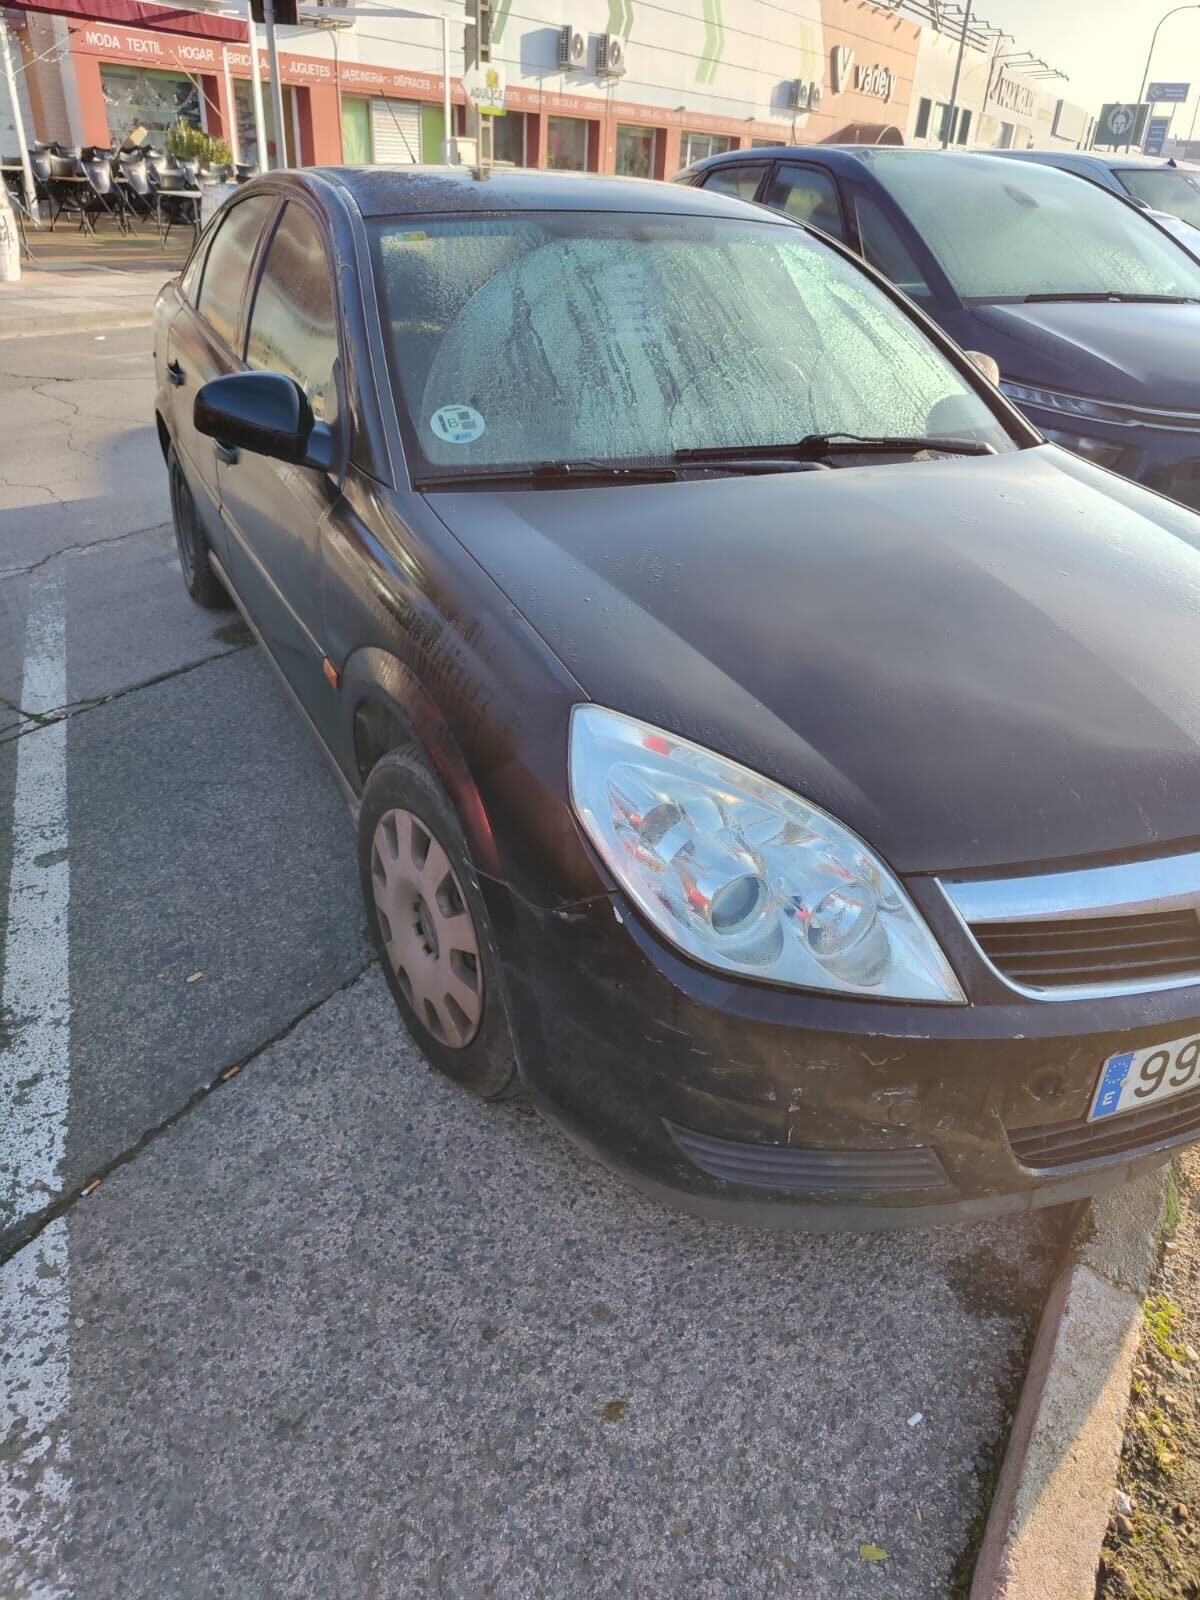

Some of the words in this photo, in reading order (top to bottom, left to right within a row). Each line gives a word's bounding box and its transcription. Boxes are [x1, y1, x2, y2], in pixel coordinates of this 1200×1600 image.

[86, 31, 121, 49] MODA
[126, 37, 164, 55] TEXTIL
[178, 45, 214, 61] HOGAR
[288, 61, 330, 77] JUGUETES
[1134, 1039, 1200, 1098] 99
[1101, 1090, 1116, 1106] E
